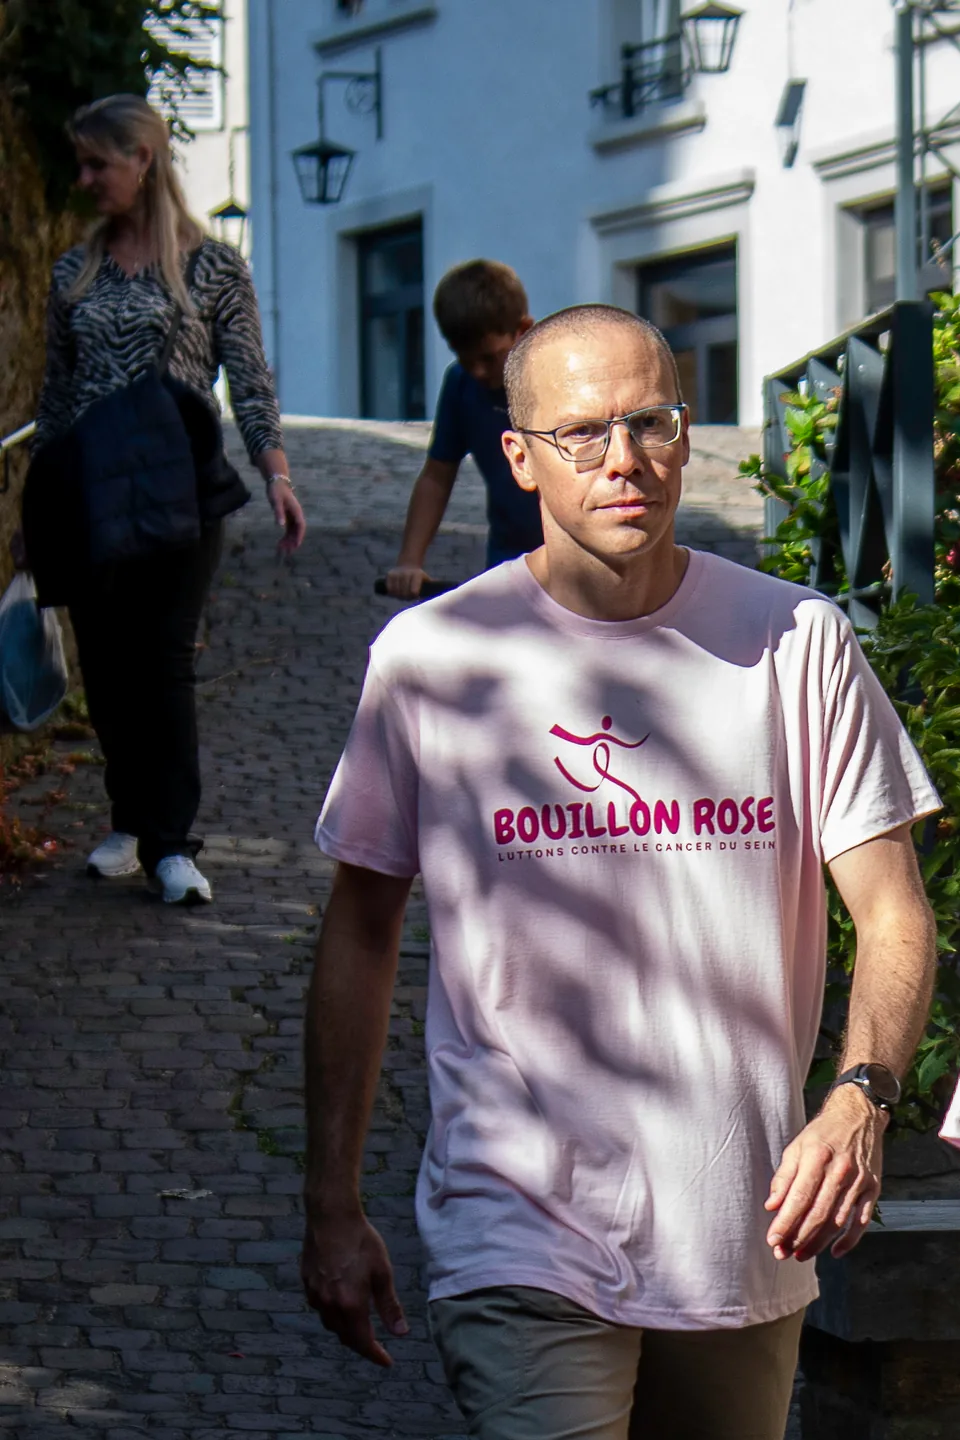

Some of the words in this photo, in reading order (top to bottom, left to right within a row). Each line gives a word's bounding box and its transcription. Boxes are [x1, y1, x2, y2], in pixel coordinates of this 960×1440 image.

[494, 799, 681, 845] BOUILLON
[693, 796, 776, 836] ROSE
[498, 847, 564, 862] LUTTONS
[571, 844, 627, 855] CONTRE
[633, 843, 649, 852] LE
[655, 841, 713, 852] CANCER
[719, 841, 738, 851] DU
[744, 840, 776, 850] SEIN
